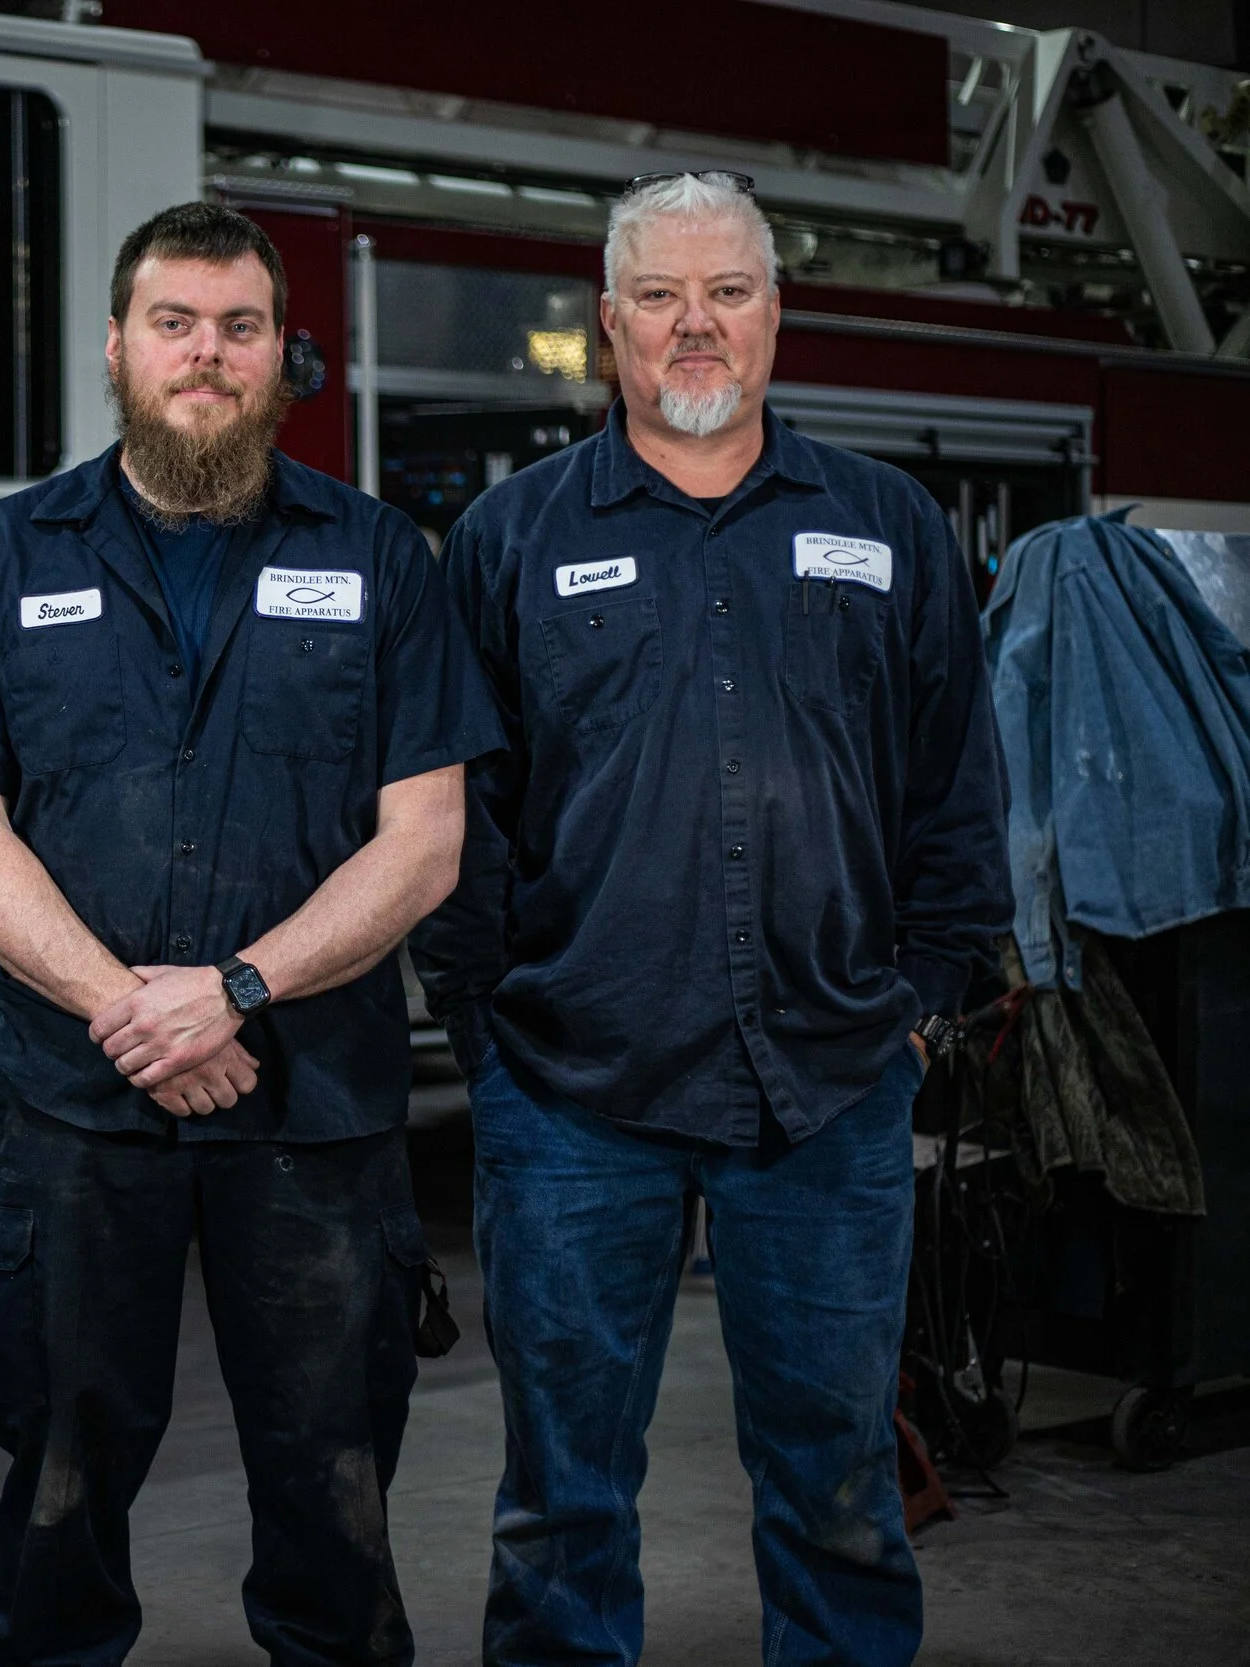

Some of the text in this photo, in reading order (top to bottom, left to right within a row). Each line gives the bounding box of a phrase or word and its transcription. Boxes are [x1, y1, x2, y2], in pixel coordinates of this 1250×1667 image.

[806, 537, 883, 554] BRINDLEE MTN.
[270, 573, 351, 585] BRINDLEE MTN.
[568, 565, 622, 587] Lowell
[807, 566, 883, 586] FIRE APPARATUS
[37, 602, 85, 620] Steven
[269, 605, 351, 617] FIRE APPARATUS
